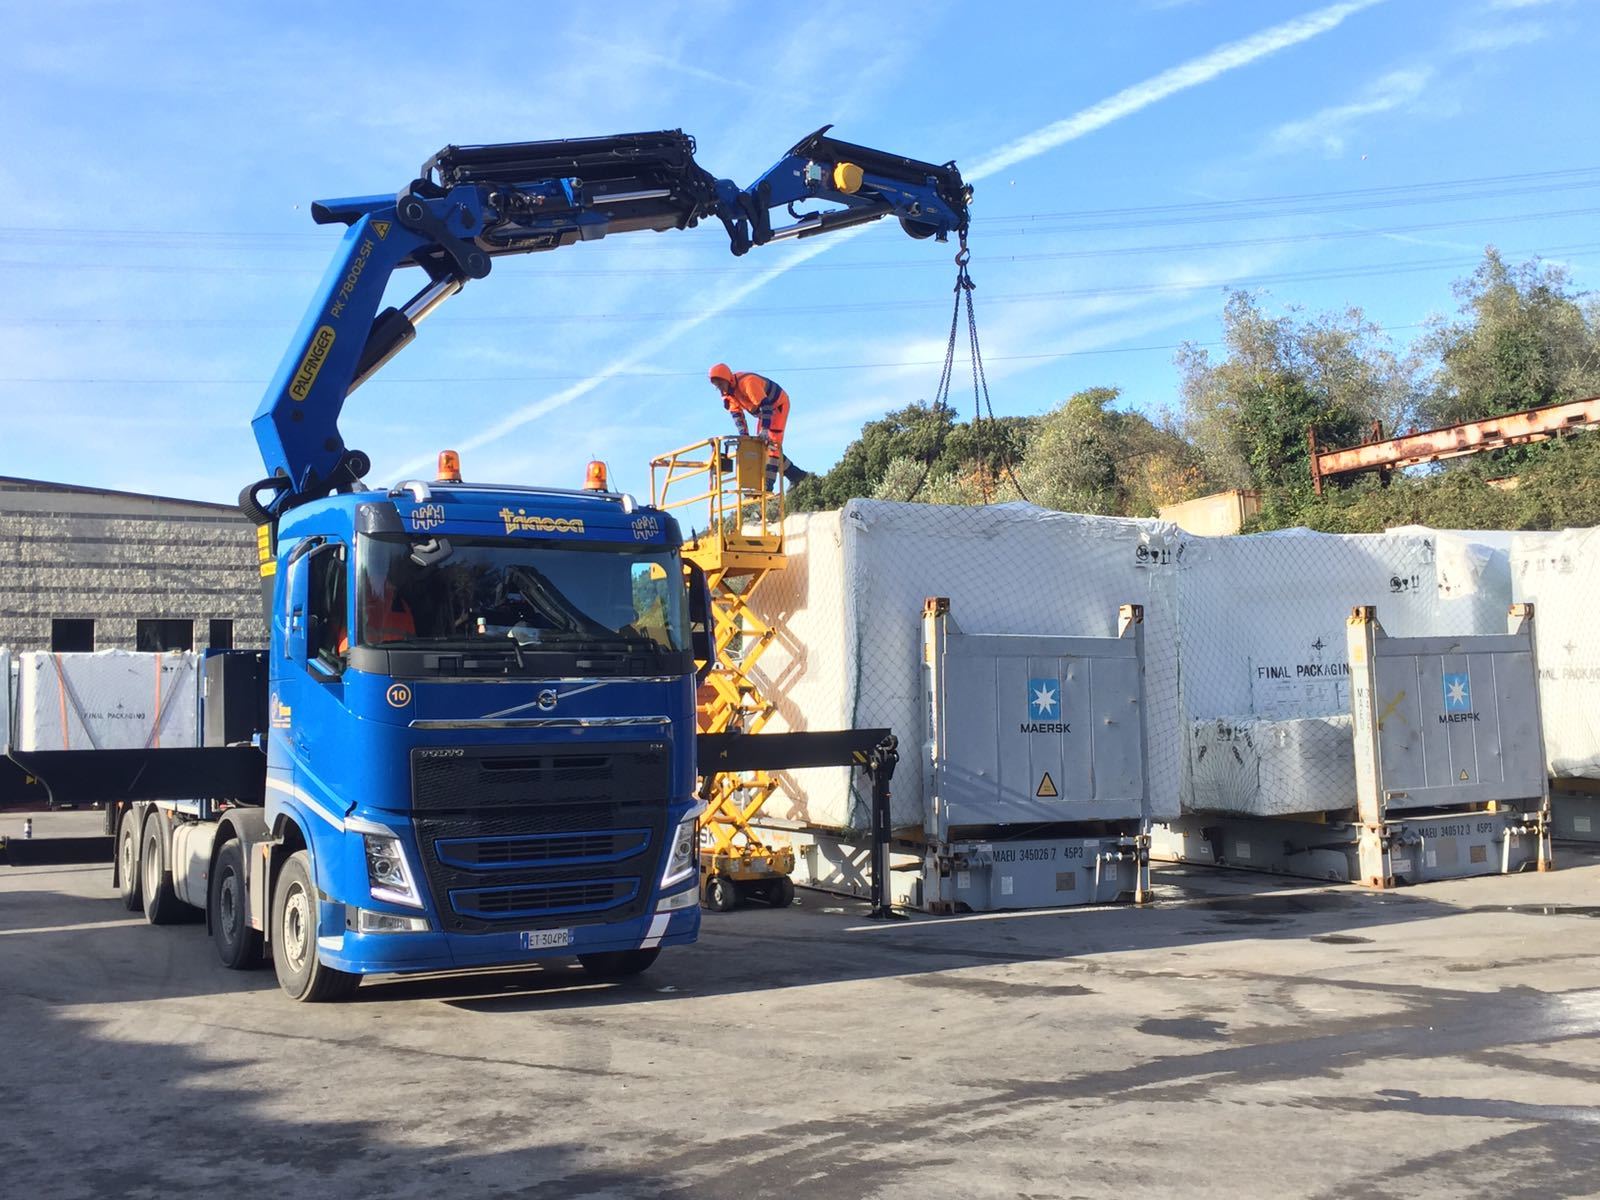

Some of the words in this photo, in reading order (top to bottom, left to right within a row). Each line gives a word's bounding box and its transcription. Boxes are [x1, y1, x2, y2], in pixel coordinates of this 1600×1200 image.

[330, 299, 346, 318] PK
[339, 239, 374, 300] 78002-SH
[292, 329, 334, 397] PALFINGER
[1258, 667, 1291, 679] FINAL
[391, 690, 406, 701] 10
[1439, 712, 1481, 723] MAERSK
[1020, 723, 1072, 734] MAERSK
[992, 849, 1016, 862] MAEU
[1063, 846, 1084, 859] 45P3
[529, 935, 540, 946] ET
[542, 932, 568, 945] 304PR
